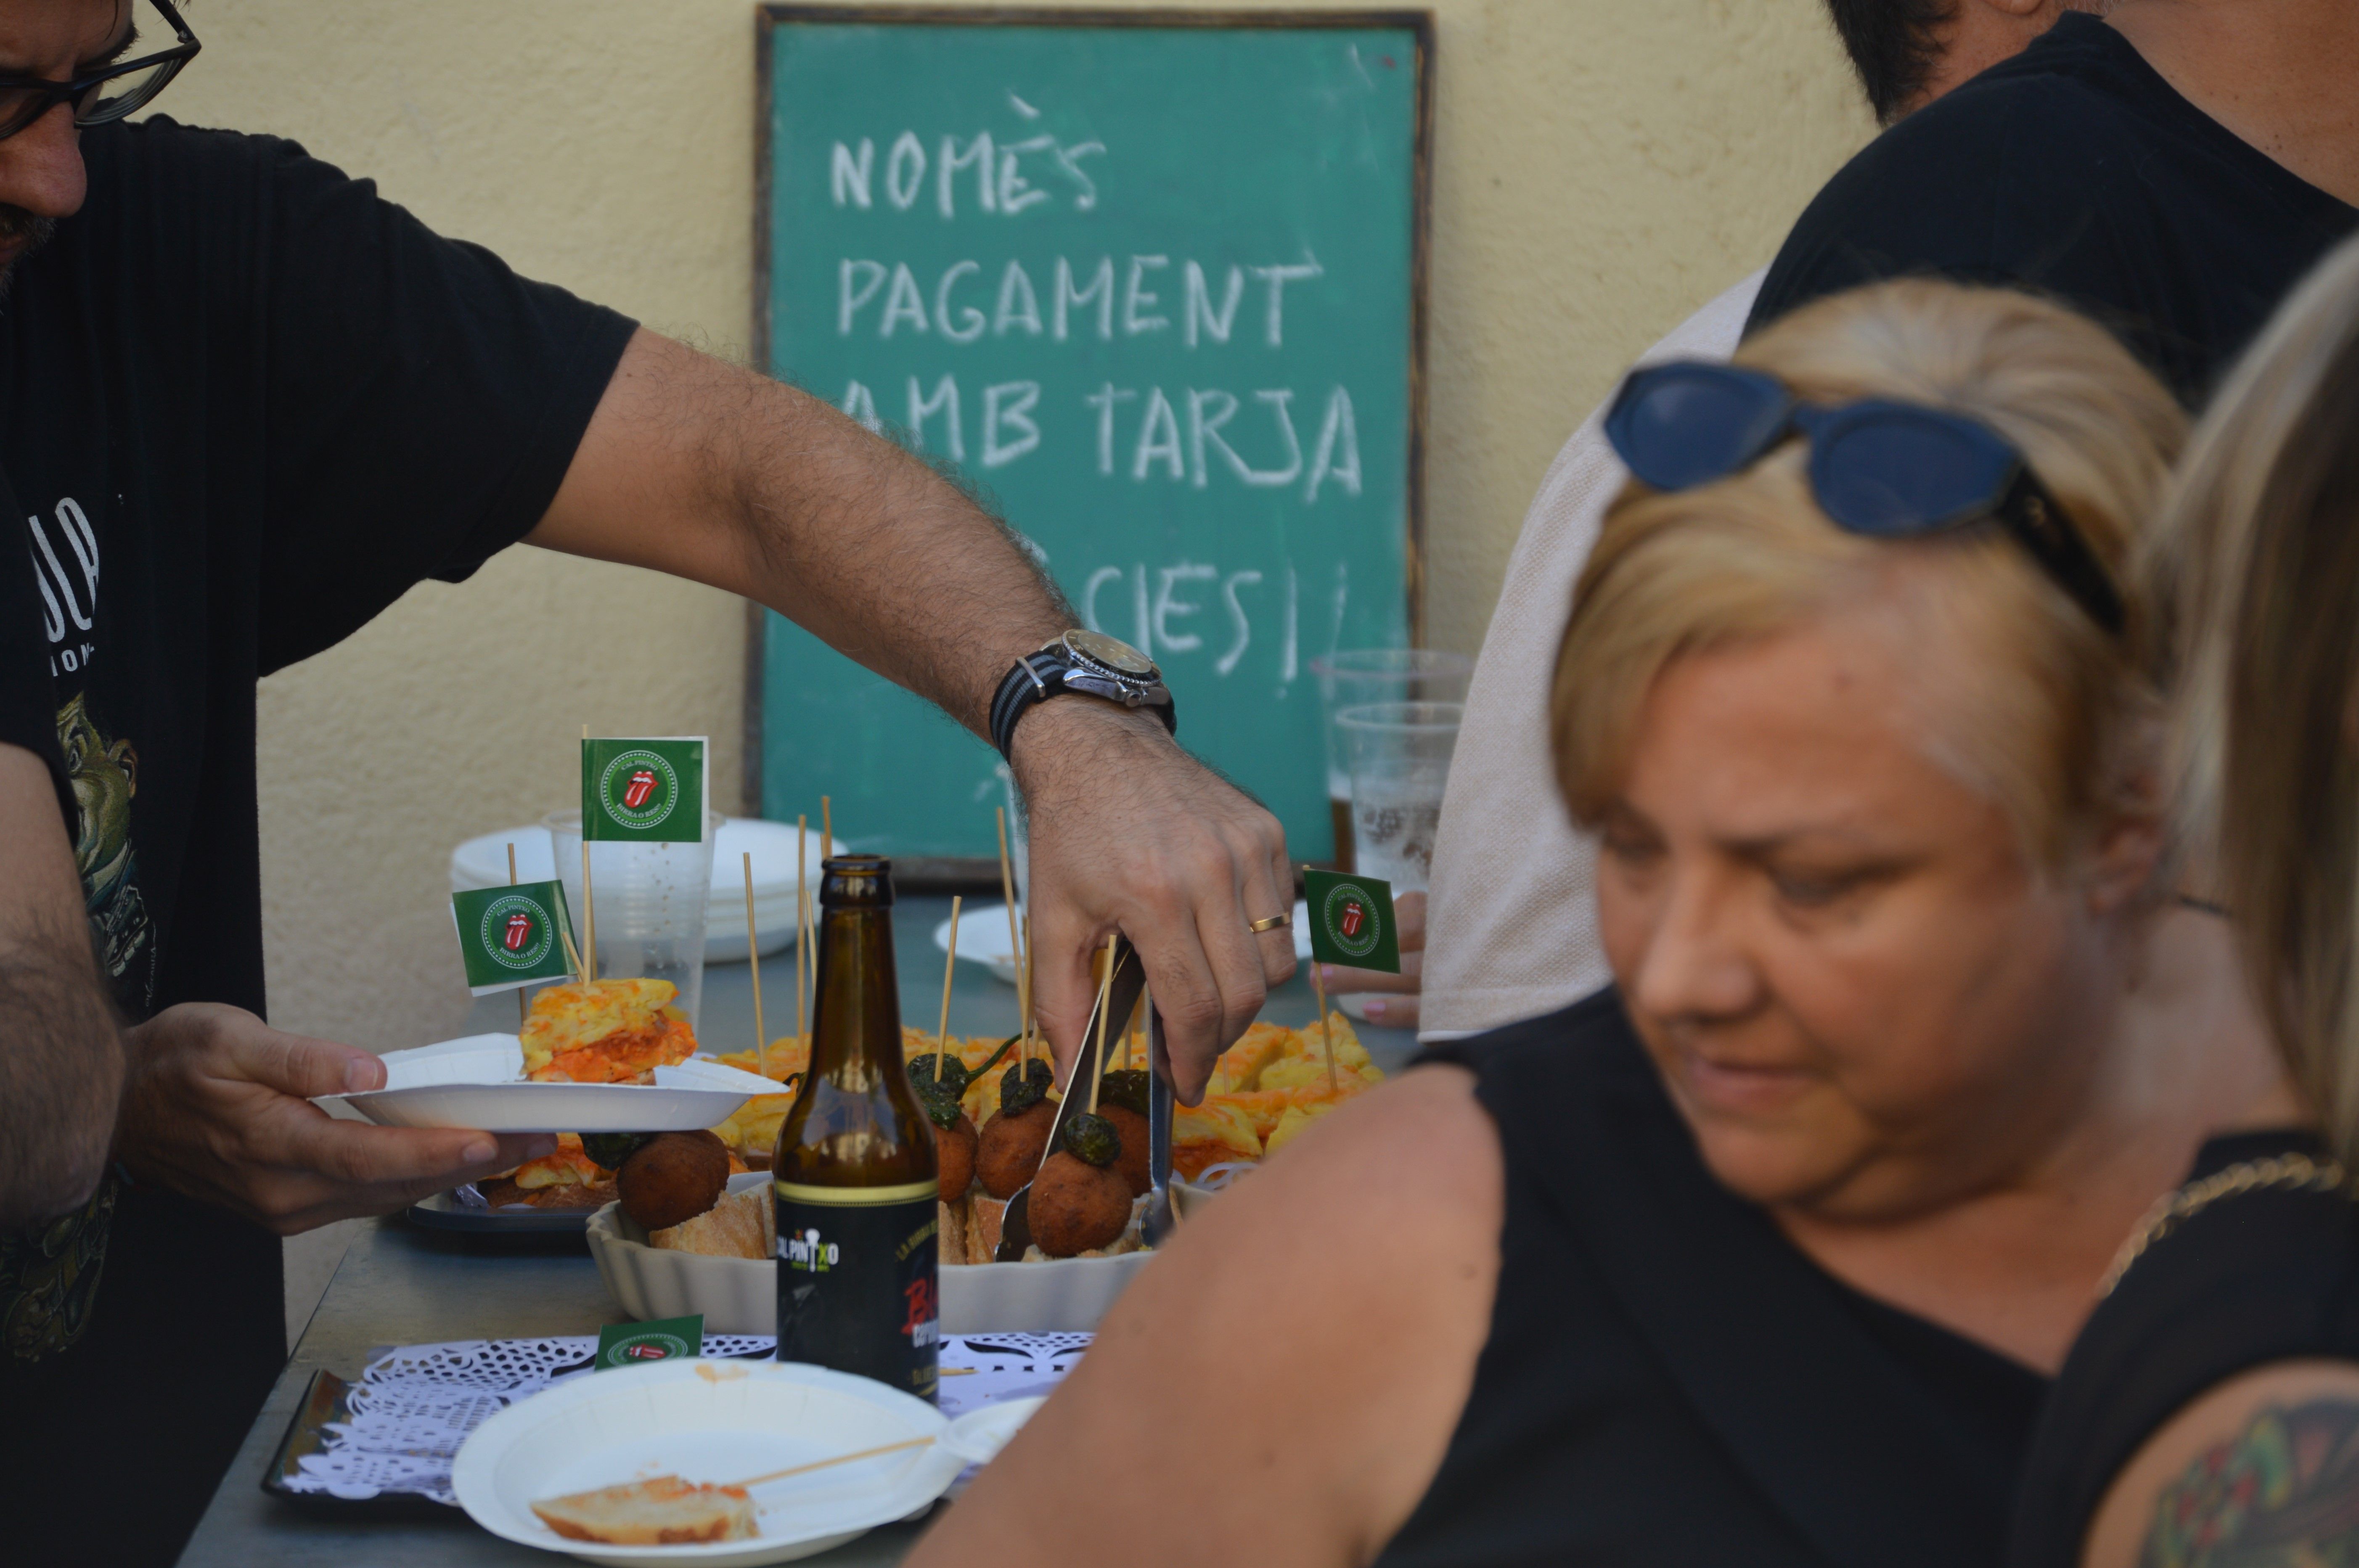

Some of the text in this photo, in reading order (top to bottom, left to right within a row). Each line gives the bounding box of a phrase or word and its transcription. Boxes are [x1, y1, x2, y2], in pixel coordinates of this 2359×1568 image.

[831, 89, 1107, 217] NOMÈS
[838, 255, 1323, 347] PAGAMENT
[1087, 378, 1362, 503] TARJA
[497, 904, 530, 916] CAL PINTXO
[500, 947, 520, 959] BIRRA
